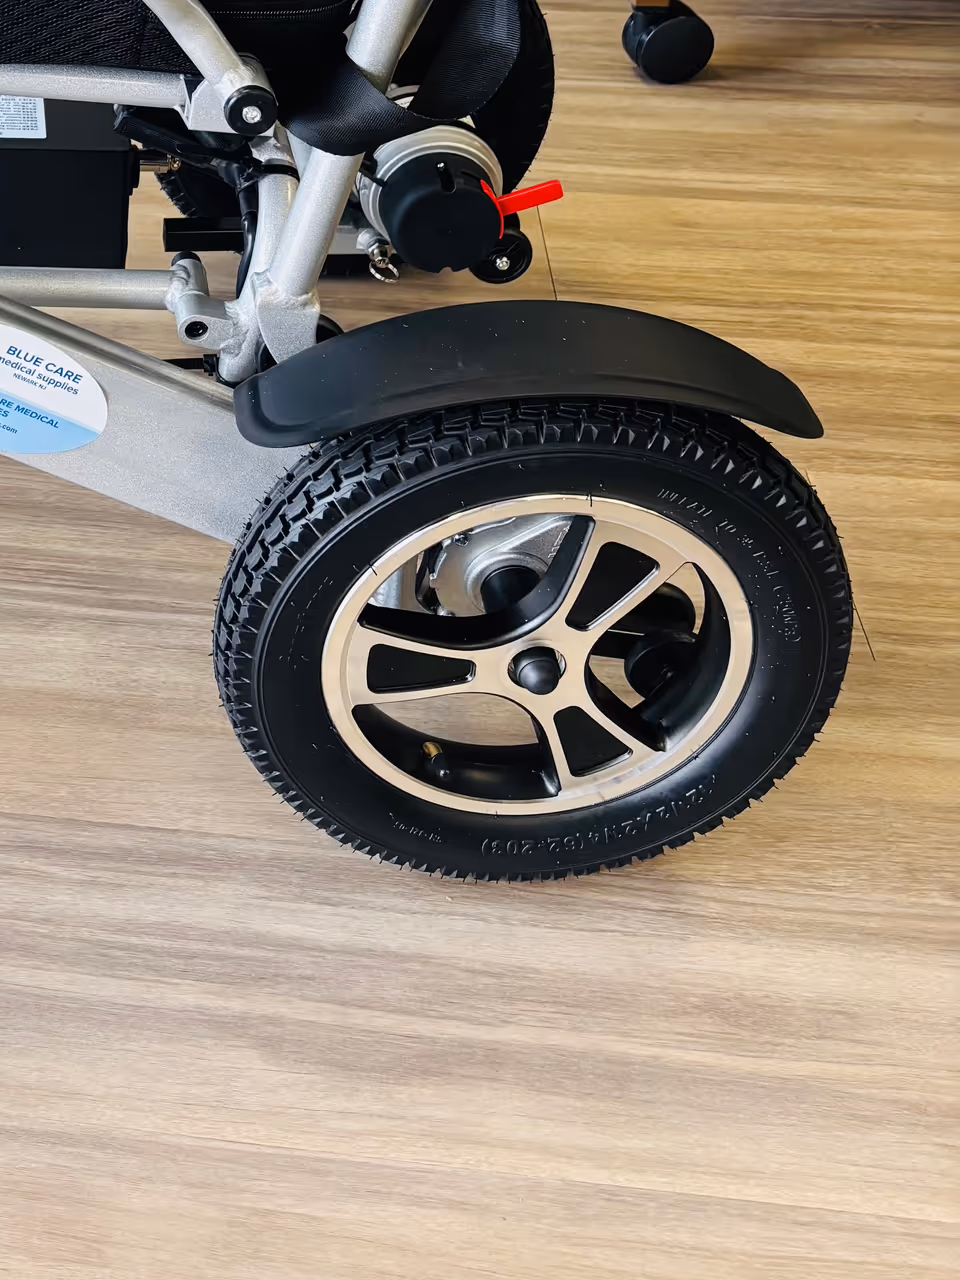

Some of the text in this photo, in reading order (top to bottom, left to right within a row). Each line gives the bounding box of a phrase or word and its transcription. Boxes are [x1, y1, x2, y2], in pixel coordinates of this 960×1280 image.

[6, 345, 83, 384] BLUE CARE
[13, 373, 38, 387] NEWARK
[36, 373, 79, 395] supplies
[14, 404, 59, 428] MEDICAL
